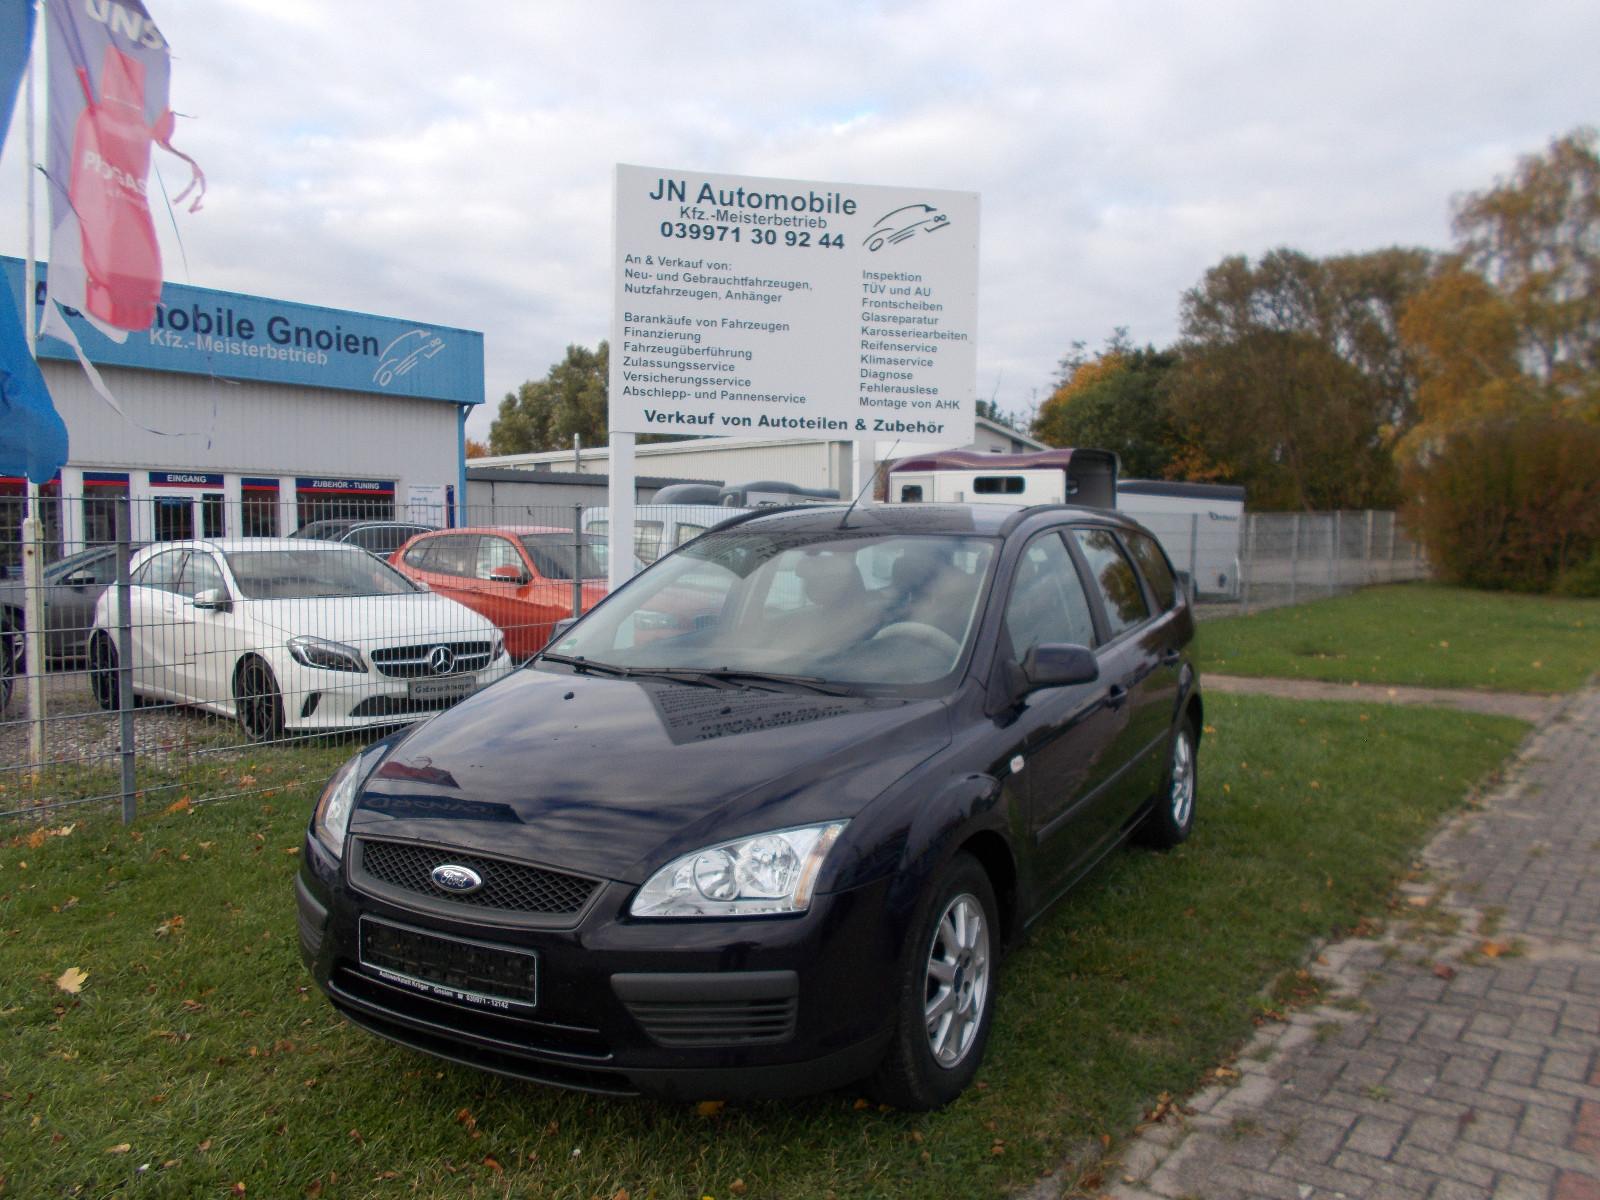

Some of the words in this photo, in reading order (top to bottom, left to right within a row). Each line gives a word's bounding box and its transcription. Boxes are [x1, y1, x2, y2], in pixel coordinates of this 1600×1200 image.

[650, 178, 686, 202] JN
[696, 182, 857, 215] Automobile
[680, 206, 827, 228] Kfz.-Meisterbetrieb
[660, 221, 740, 242] 039971
[751, 228, 777, 245] 30
[785, 230, 811, 247] 92
[818, 232, 845, 249] 44
[625, 254, 641, 265] An
[645, 255, 654, 265] &
[658, 255, 703, 268] Verkauf
[707, 262, 732, 271] von:
[625, 268, 653, 279] Neu-
[656, 271, 679, 282] und
[862, 270, 922, 282] Inspektion
[624, 283, 722, 301] Nutzfahrzeugen,
[725, 290, 782, 304] Anhänger
[862, 282, 886, 294] TÜV
[889, 286, 911, 296] und
[914, 287, 931, 297] AU
[862, 297, 943, 311] Frontscheiben
[624, 312, 692, 326] Barankäufe
[696, 319, 718, 328] von
[722, 318, 790, 334] Fahrzeugen
[861, 311, 939, 325] Glasreparatur
[266, 315, 380, 357] Gnoien
[624, 326, 701, 343] Finanzierung
[861, 326, 968, 341] Karosseriearbeiten
[150, 328, 328, 367] Kfz.-Meisterbetrieb
[624, 341, 753, 360] Fahrzeugüberführung
[860, 340, 938, 353] Reifenservice
[623, 356, 735, 372] Zulassungsservice
[860, 354, 934, 367] Klimaservice
[623, 371, 751, 387] Versicherungsservice
[860, 368, 913, 381] Diagnose
[622, 385, 691, 401] Abschlepp-
[694, 390, 717, 400] und
[721, 390, 806, 404] Pannenservice
[860, 382, 939, 395] Fehlerauslese
[859, 397, 907, 410] Montage
[911, 400, 932, 409] von
[935, 400, 960, 410] AHK
[644, 409, 715, 426] Verkauf
[722, 415, 752, 427] von
[758, 415, 848, 431] Autoteilen
[855, 418, 867, 431] &
[873, 418, 945, 434] Zubehör
[167, 474, 207, 484] EINGANG
[312, 479, 349, 489] ZUBEHÖR
[353, 481, 380, 490] TUNING
[441, 870, 467, 888] Ford
